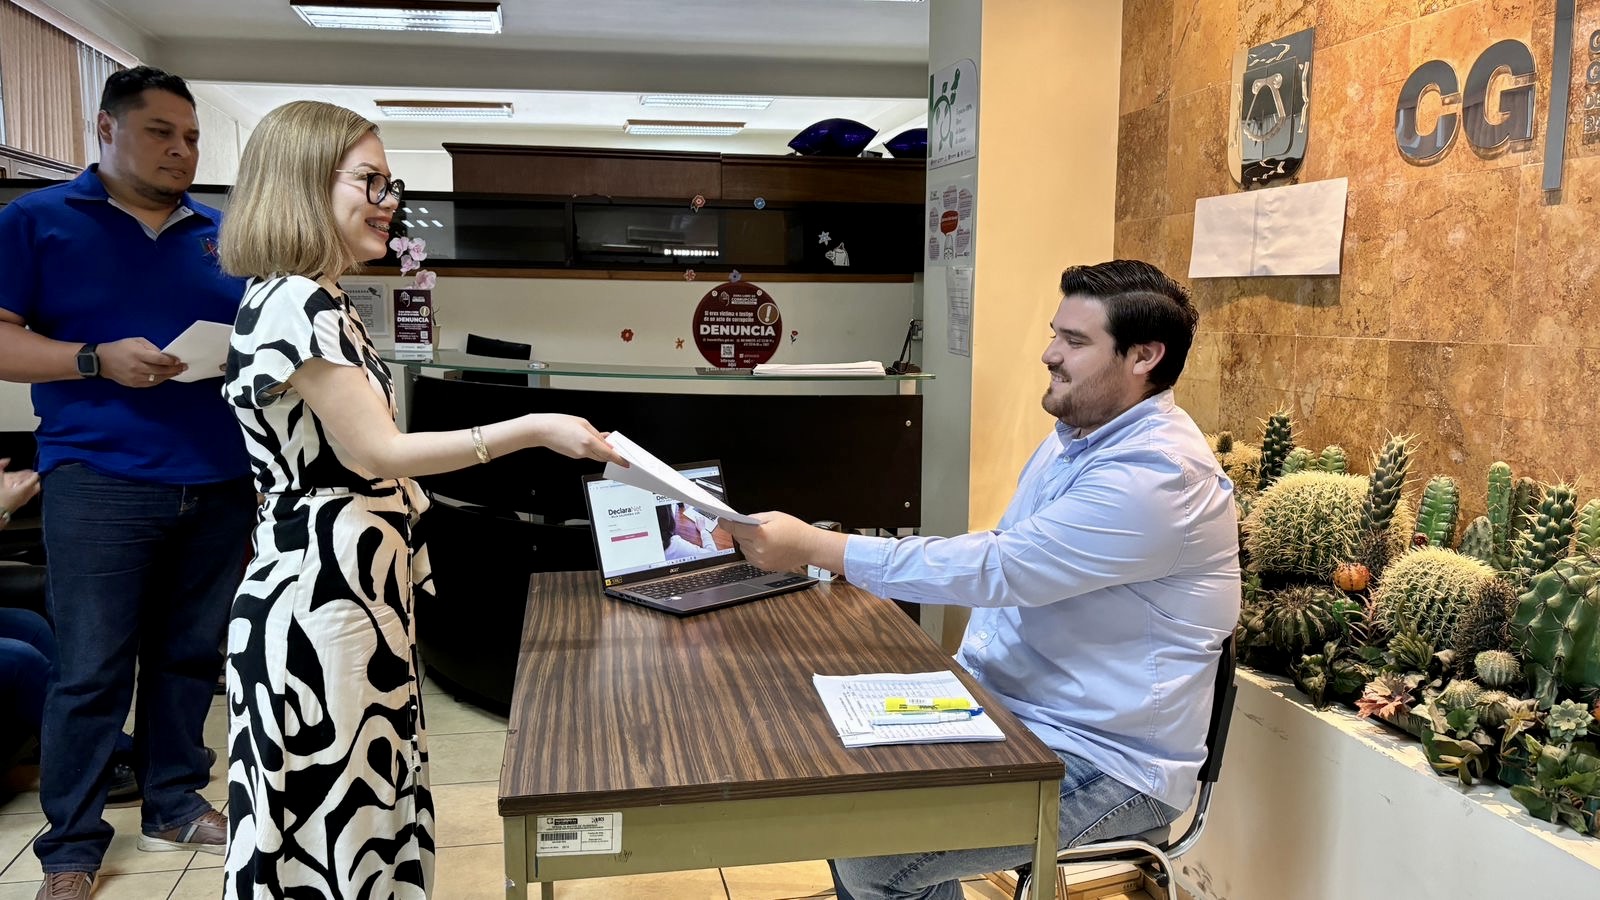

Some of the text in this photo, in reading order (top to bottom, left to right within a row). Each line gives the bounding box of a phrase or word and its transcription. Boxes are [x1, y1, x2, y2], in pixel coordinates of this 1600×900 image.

[1395, 39, 1537, 159] CG
[700, 325, 775, 336] DENUNCIA
[608, 506, 642, 516] DeclaraNet
